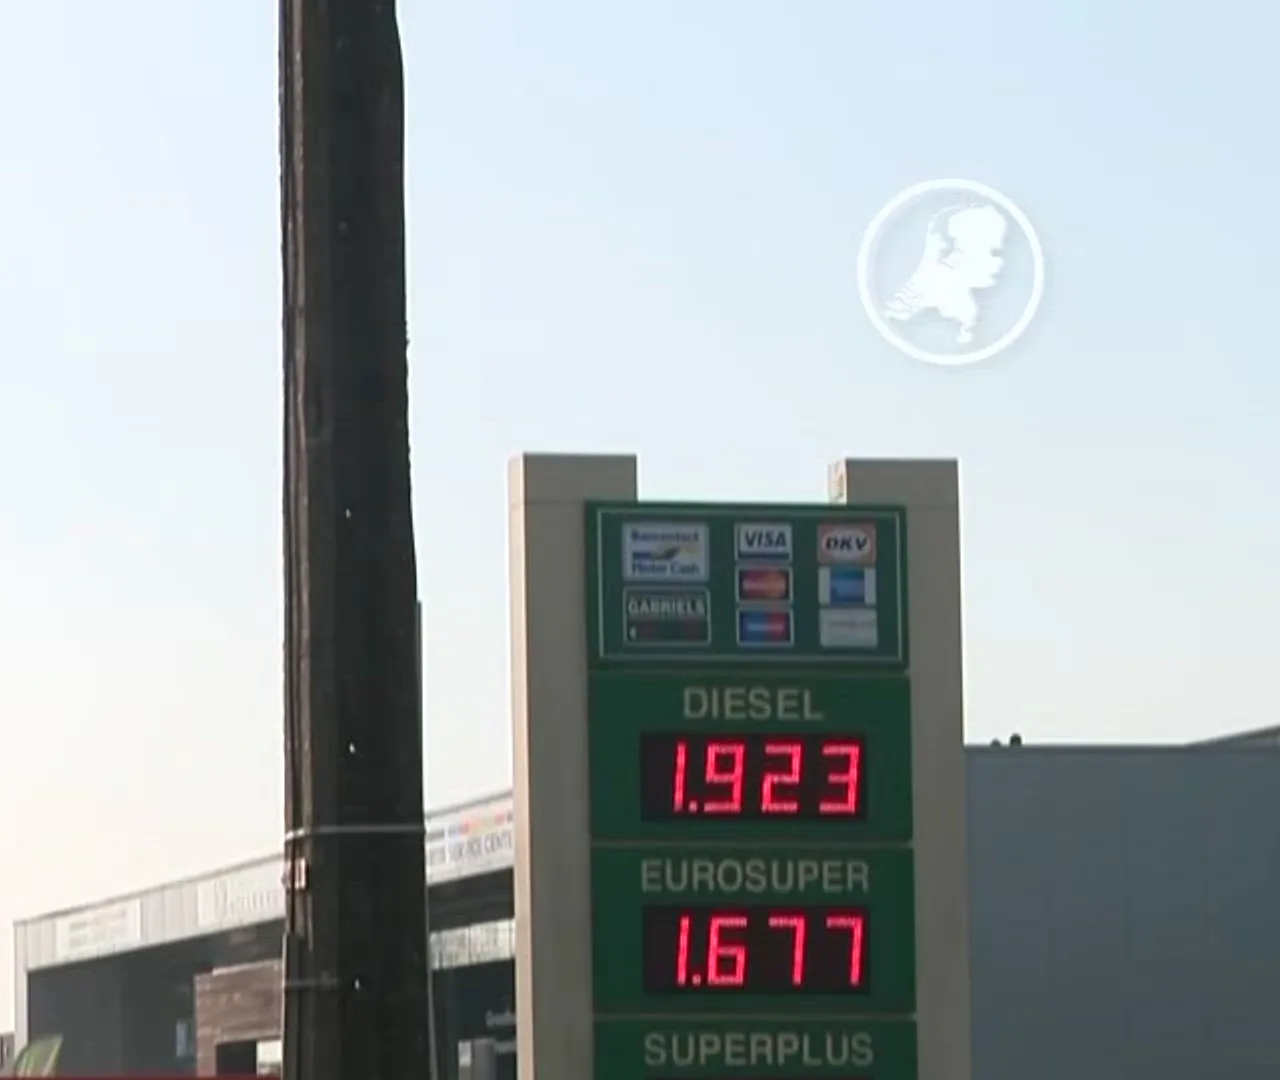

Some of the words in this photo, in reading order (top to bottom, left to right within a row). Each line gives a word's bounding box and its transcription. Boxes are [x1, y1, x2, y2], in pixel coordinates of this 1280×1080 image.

[743, 530, 787, 548] VISA
[824, 536, 869, 551] DKV
[628, 597, 706, 616] GABRIELS
[683, 687, 825, 720] DIESEL
[672, 740, 862, 815] 1.923
[641, 858, 870, 894] EUROSUPER
[675, 914, 865, 987] 1.677
[644, 1032, 875, 1067] SUPERPLUS
